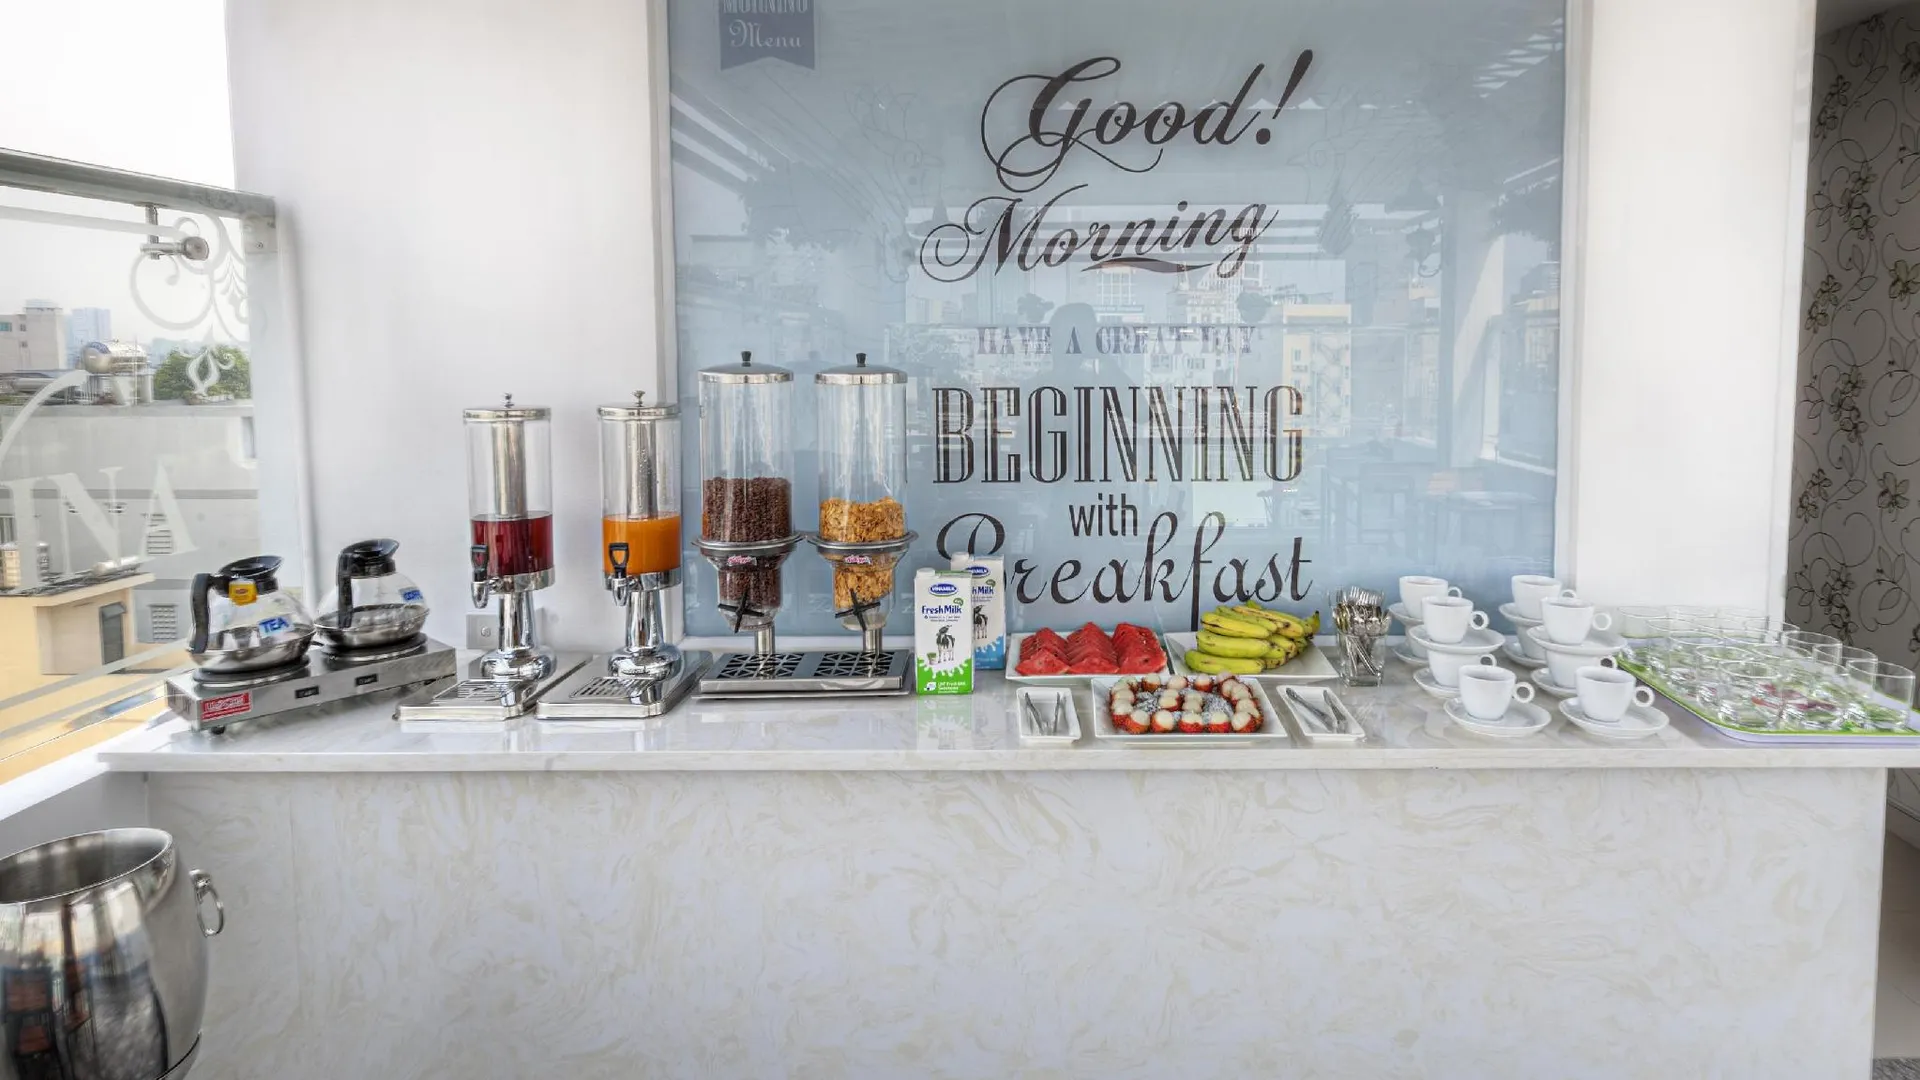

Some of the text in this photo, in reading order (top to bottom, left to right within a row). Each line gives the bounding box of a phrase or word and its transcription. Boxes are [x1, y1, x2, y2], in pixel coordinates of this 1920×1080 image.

[729, 19, 802, 48] Menu
[981, 49, 1313, 192] Good!
[920, 184, 1279, 282] Morning
[977, 326, 1052, 355] HAVE
[1065, 326, 1082, 355] A
[1096, 326, 1188, 355] GREAT
[932, 386, 1304, 484] BEGINNING
[1069, 493, 1139, 537] with
[977, 586, 994, 595] Milk
[921, 604, 962, 614] Fresh Milk
[259, 617, 289, 633] TEA
